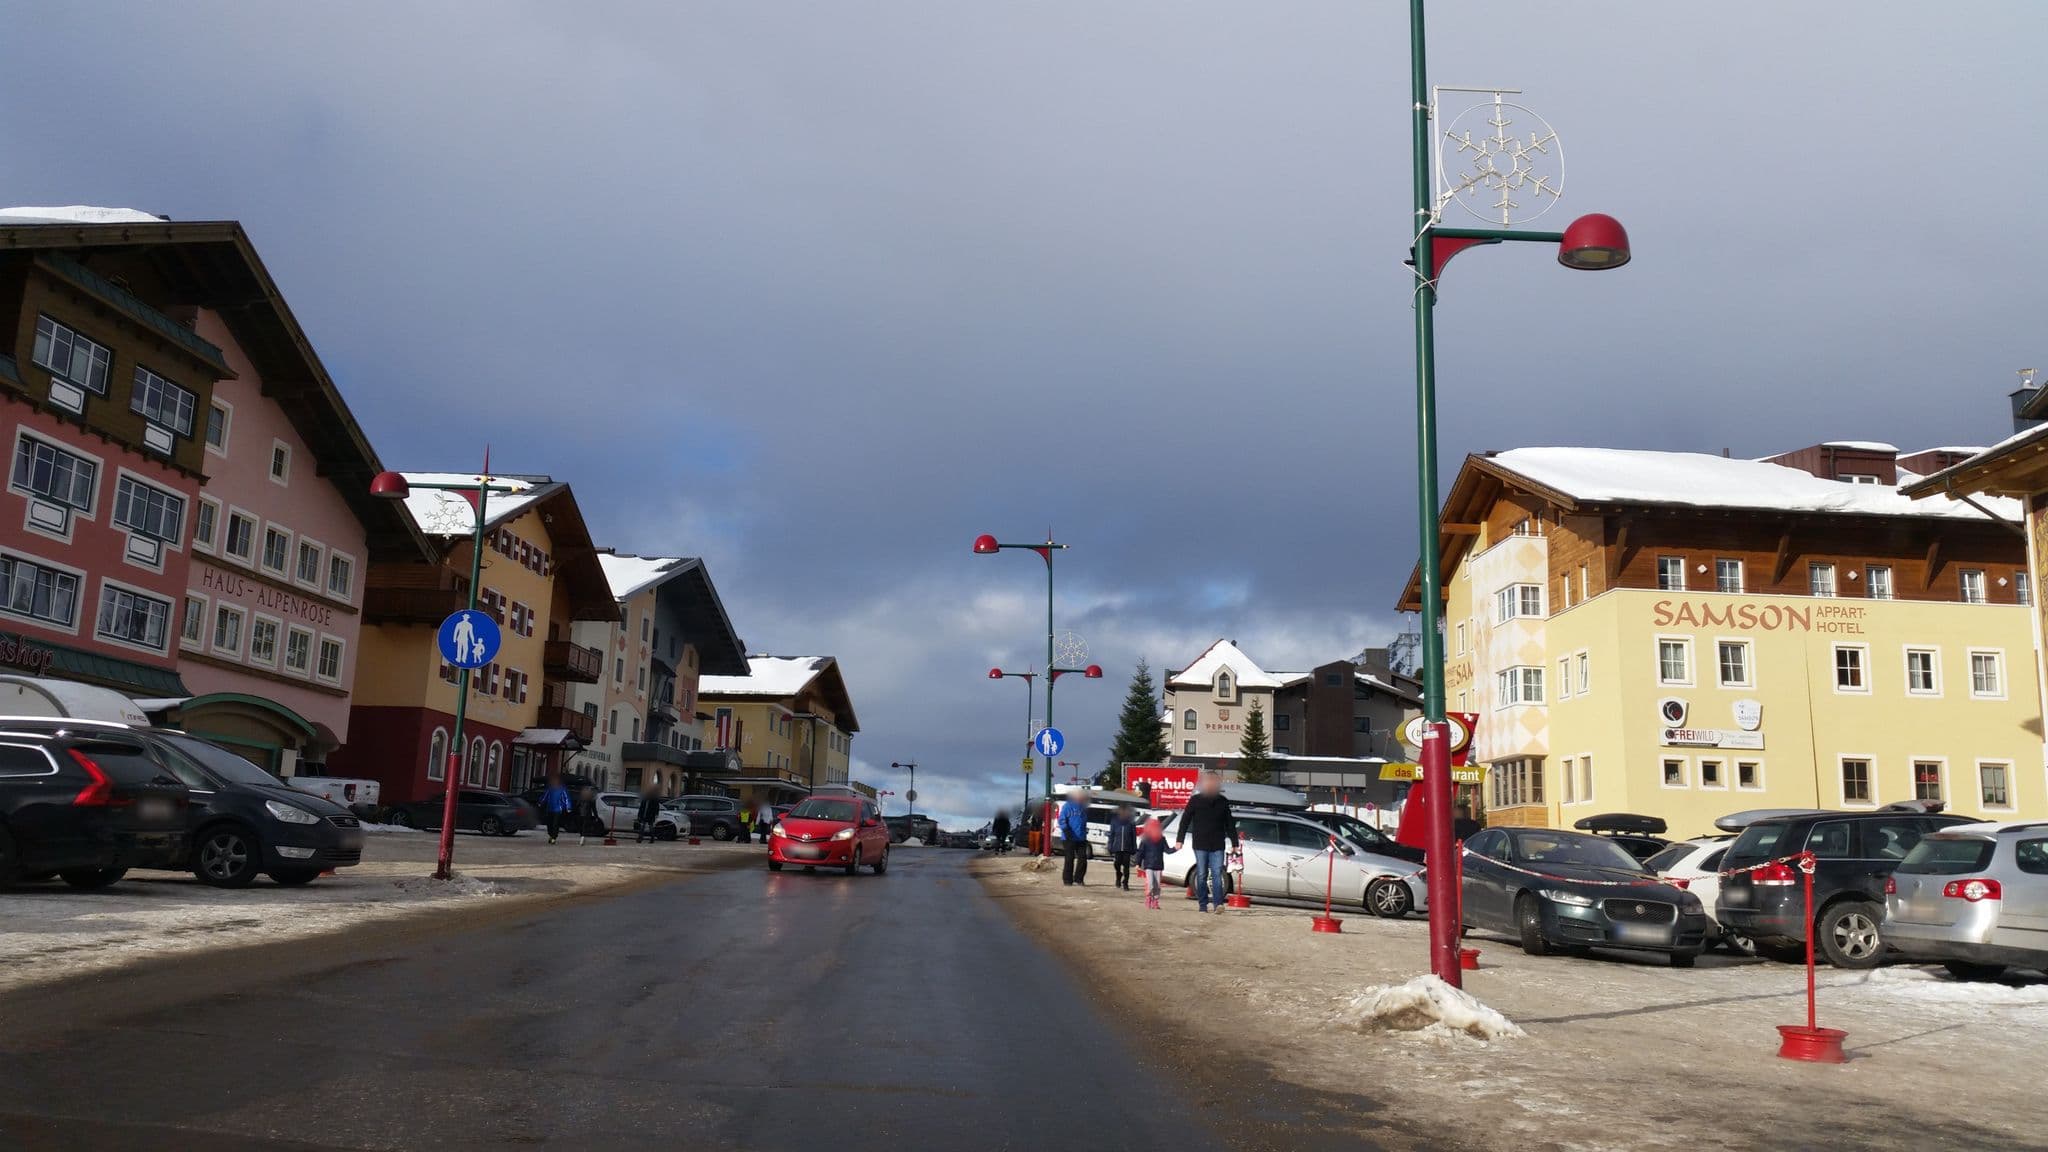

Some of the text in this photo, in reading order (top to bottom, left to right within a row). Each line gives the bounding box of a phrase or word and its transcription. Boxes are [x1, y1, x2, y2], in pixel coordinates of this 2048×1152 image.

[203, 567, 244, 597] HAUS
[256, 585, 331, 626] ALPENROSE
[1653, 600, 1866, 632] SAMSON APPART-
[1816, 621, 1865, 634] HOTEL
[1395, 767, 1412, 777] das
